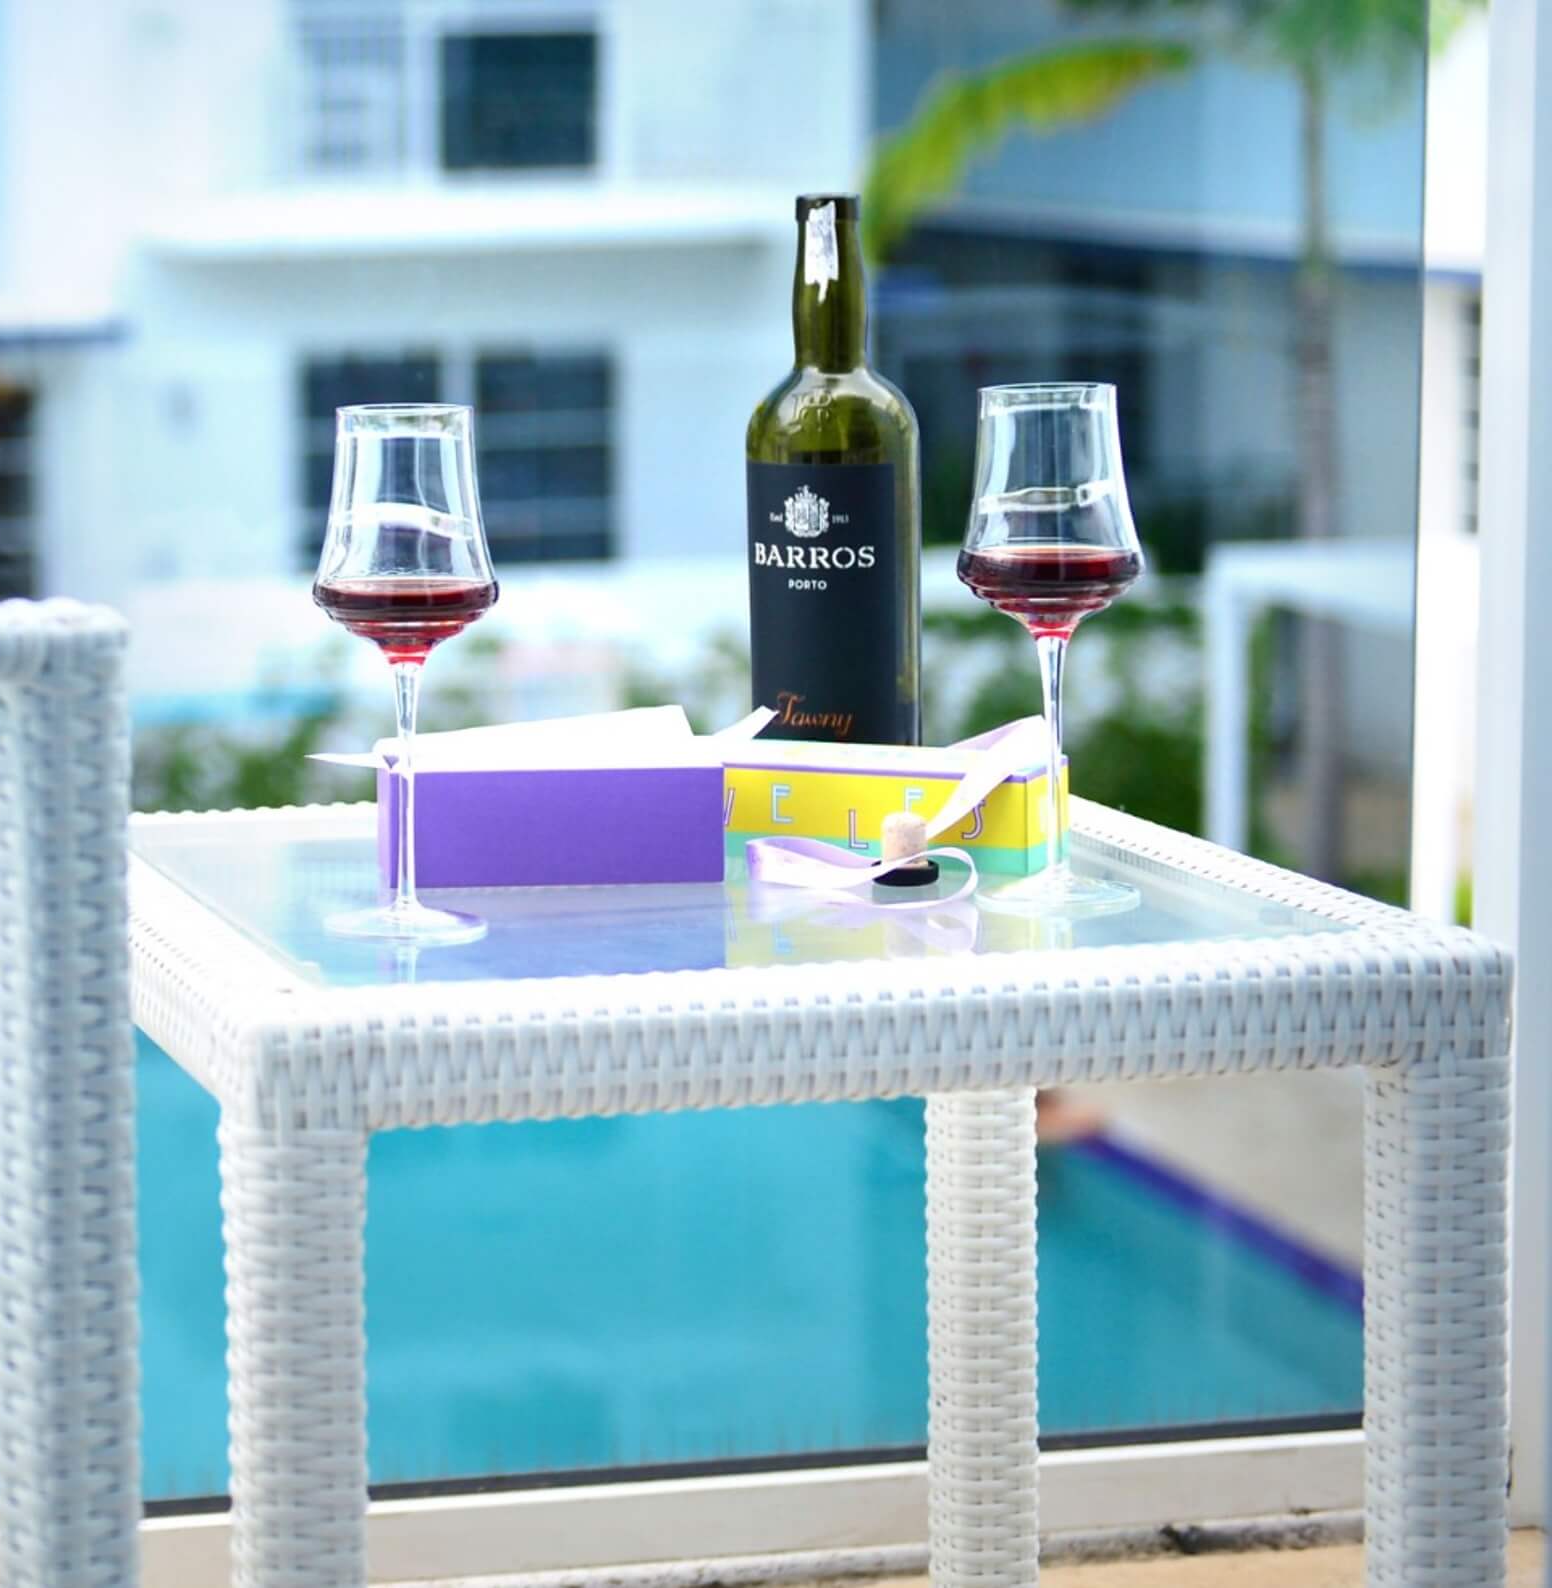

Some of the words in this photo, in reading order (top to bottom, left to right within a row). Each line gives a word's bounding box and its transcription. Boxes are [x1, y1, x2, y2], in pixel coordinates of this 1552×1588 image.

[754, 542, 876, 569] BARROS
[788, 579, 828, 590] PORTO
[776, 691, 853, 737] Tawny
